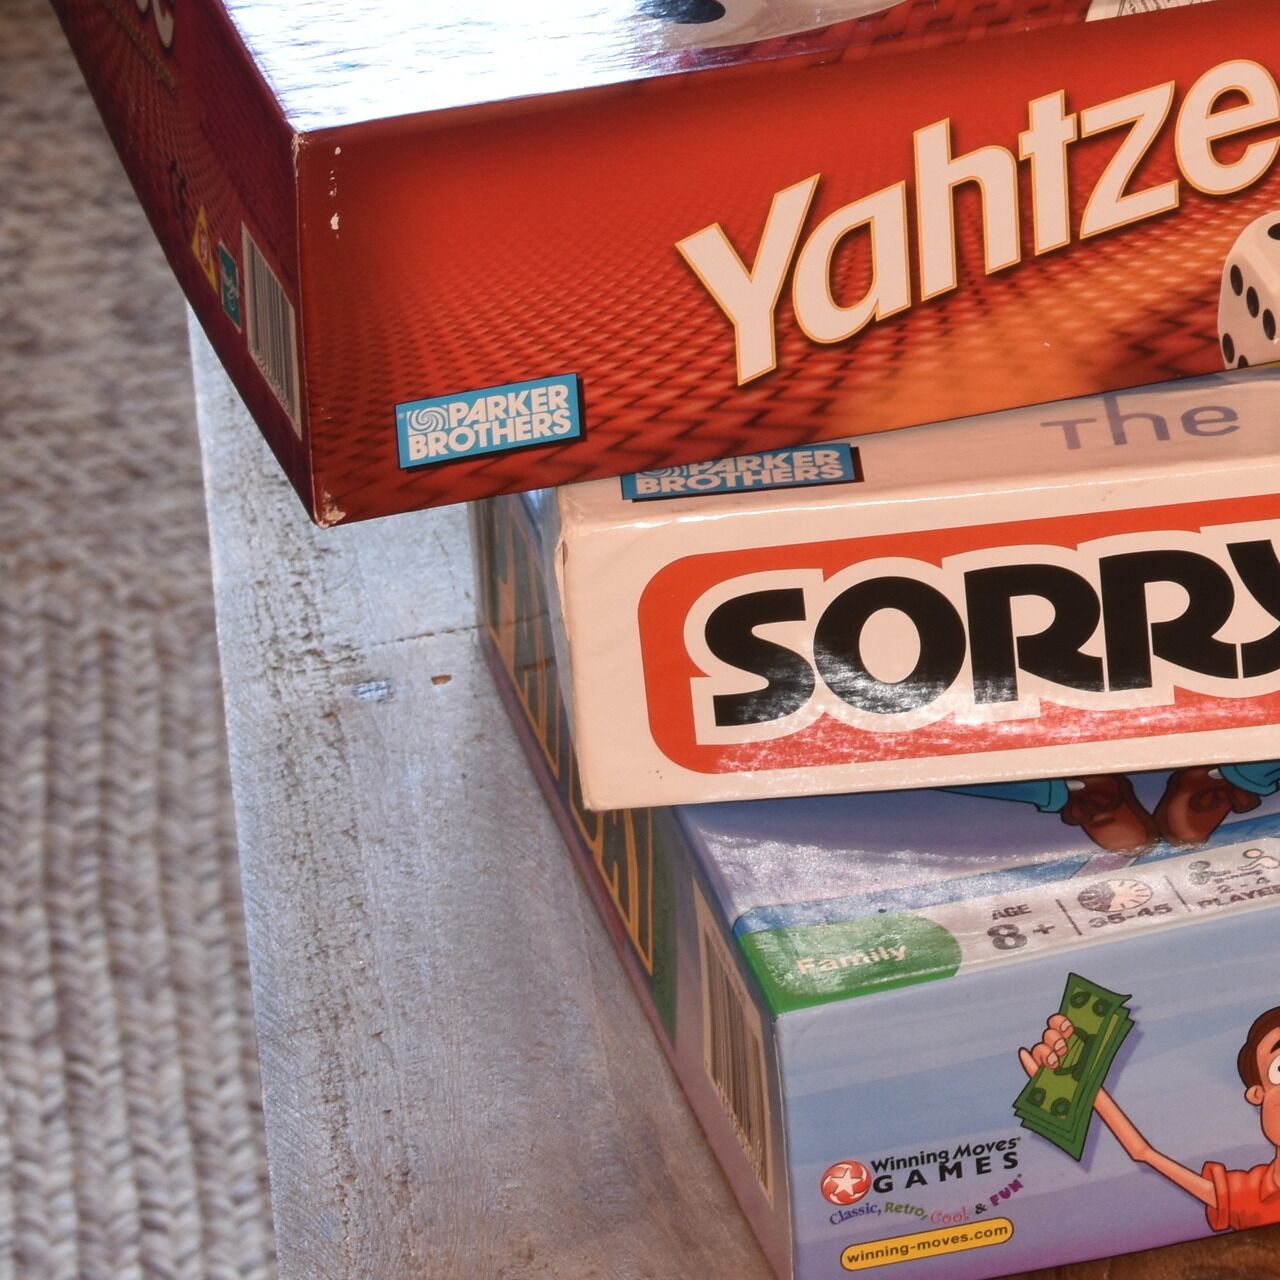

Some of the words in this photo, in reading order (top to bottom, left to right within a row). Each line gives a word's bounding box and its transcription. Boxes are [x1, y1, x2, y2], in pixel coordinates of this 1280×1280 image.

[448, 384, 569, 427] PARKER
[1040, 394, 1241, 453] The
[407, 408, 572, 462] BROTHERS
[636, 462, 844, 496] BROTHERS
[991, 903, 1030, 921] AGE
[985, 920, 1056, 951] 8+
[796, 943, 906, 976] Family
[870, 1149, 949, 1174] Winning
[953, 1137, 1017, 1161] Moves
[873, 1151, 1020, 1194] GAMES
[829, 1202, 883, 1226] Classic,
[884, 1201, 928, 1221] Retro,
[975, 1203, 987, 1215] &
[989, 1179, 1024, 1207] FUN
[846, 1225, 1009, 1265] winning-moves.com
